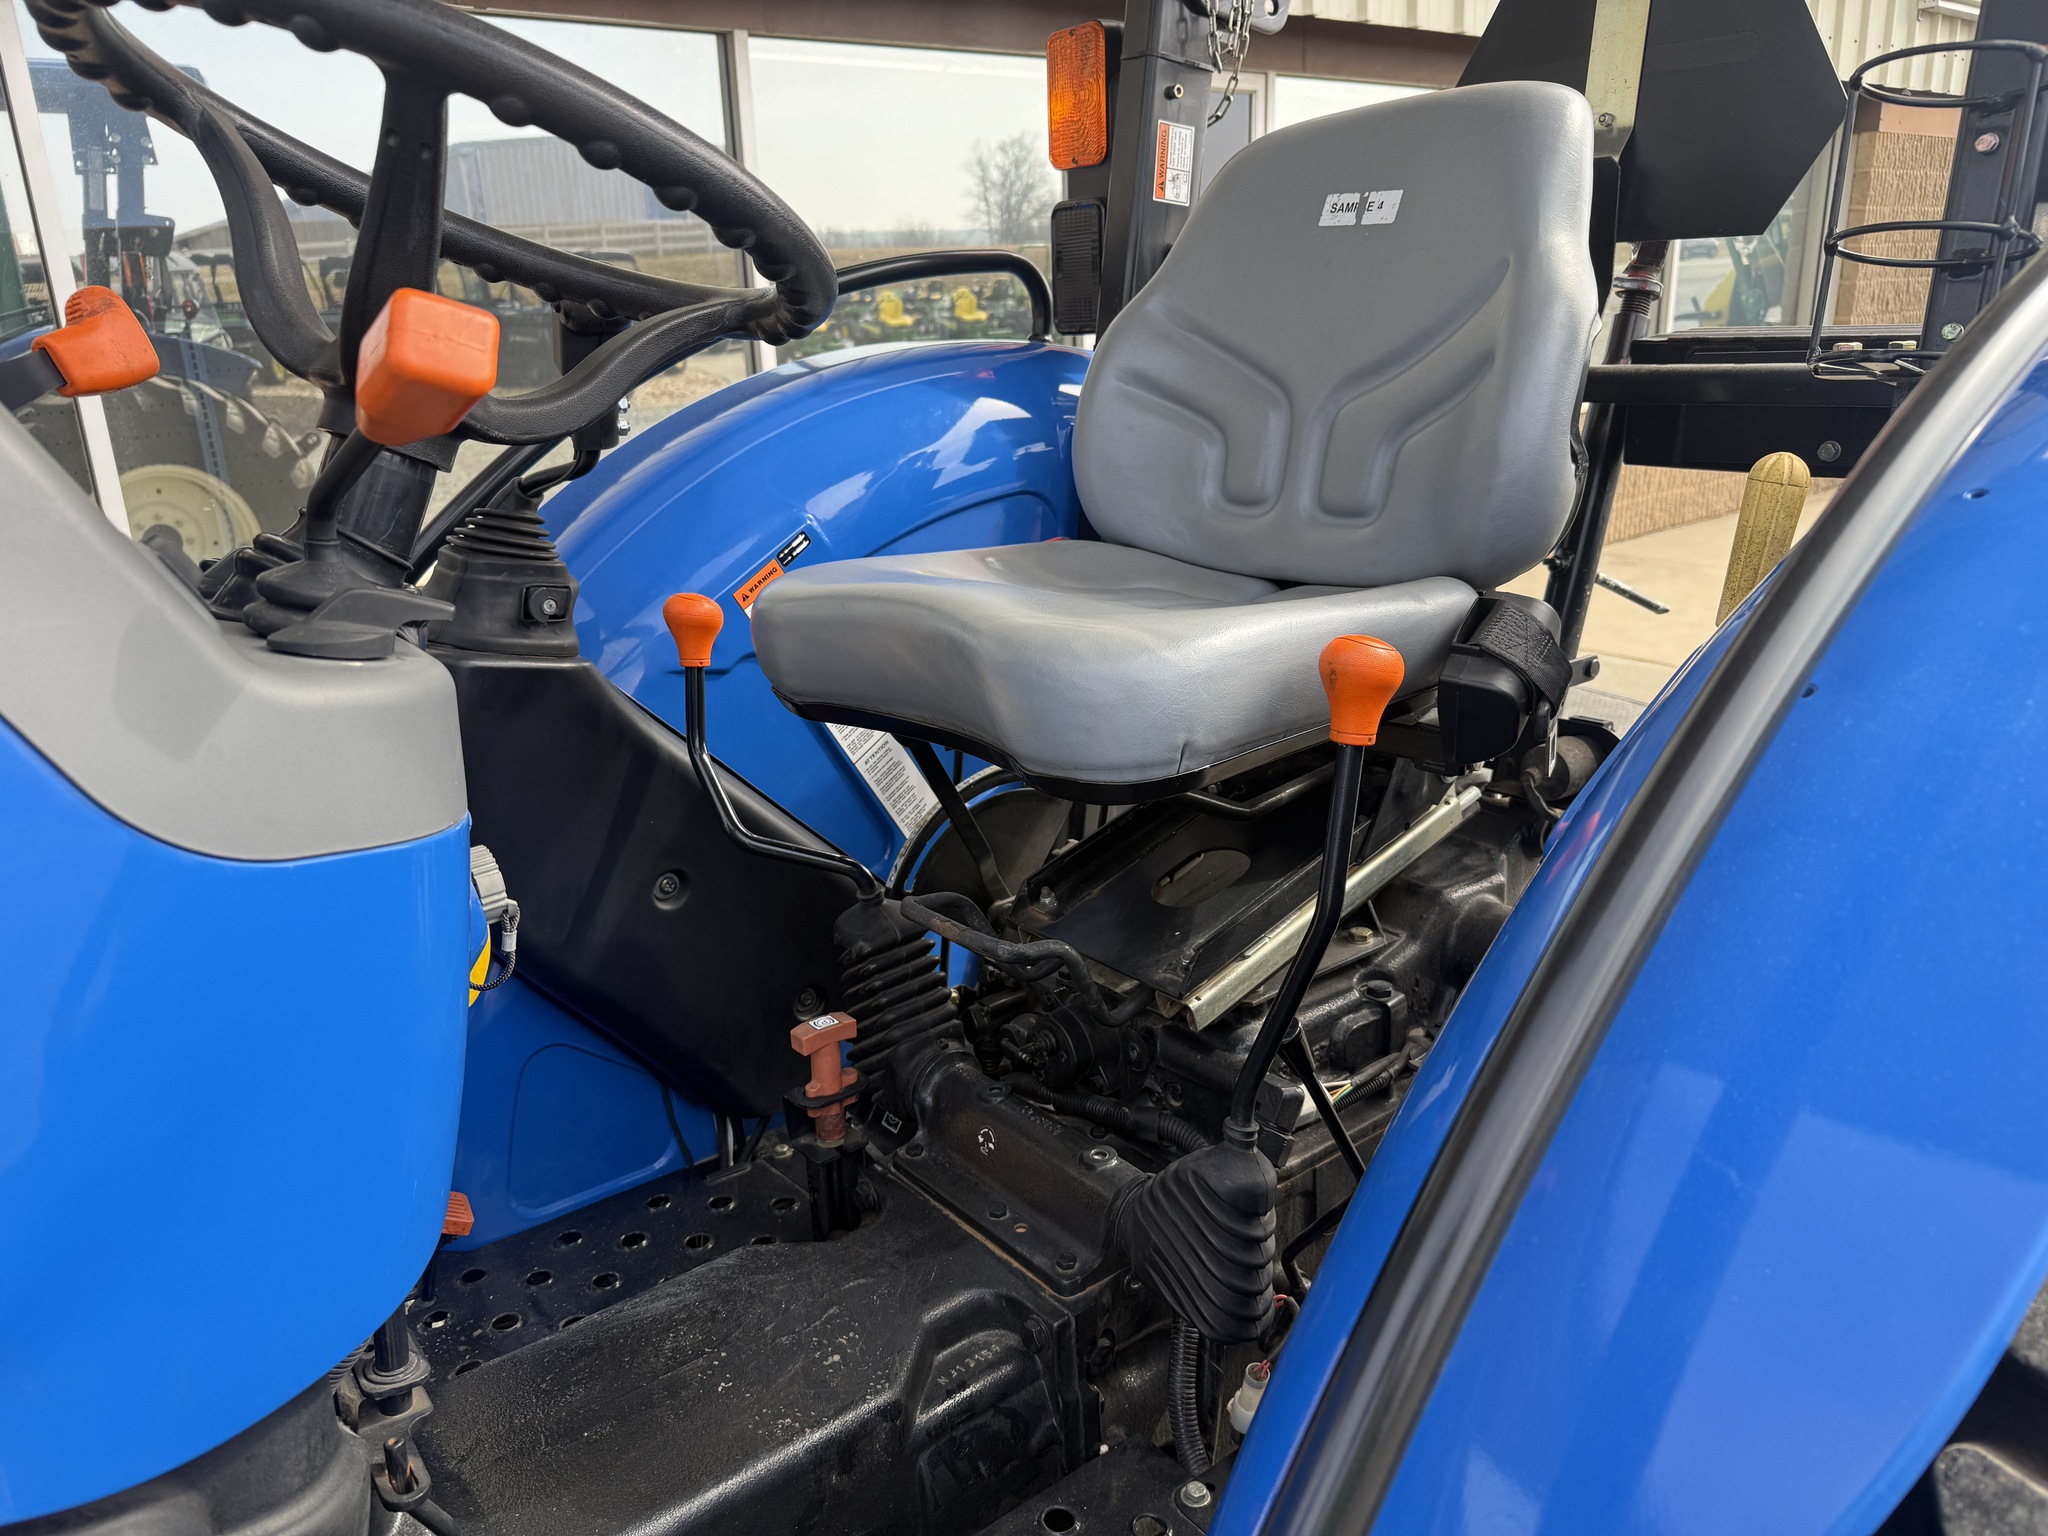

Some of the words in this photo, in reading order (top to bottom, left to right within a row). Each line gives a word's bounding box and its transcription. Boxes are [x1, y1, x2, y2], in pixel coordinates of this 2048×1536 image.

[1159, 130, 1168, 179] WARNING
[1330, 201, 1376, 214] SAME
[1377, 200, 1385, 209] 4
[748, 566, 779, 594] WARNING
[864, 739, 890, 766] ATTENTION
